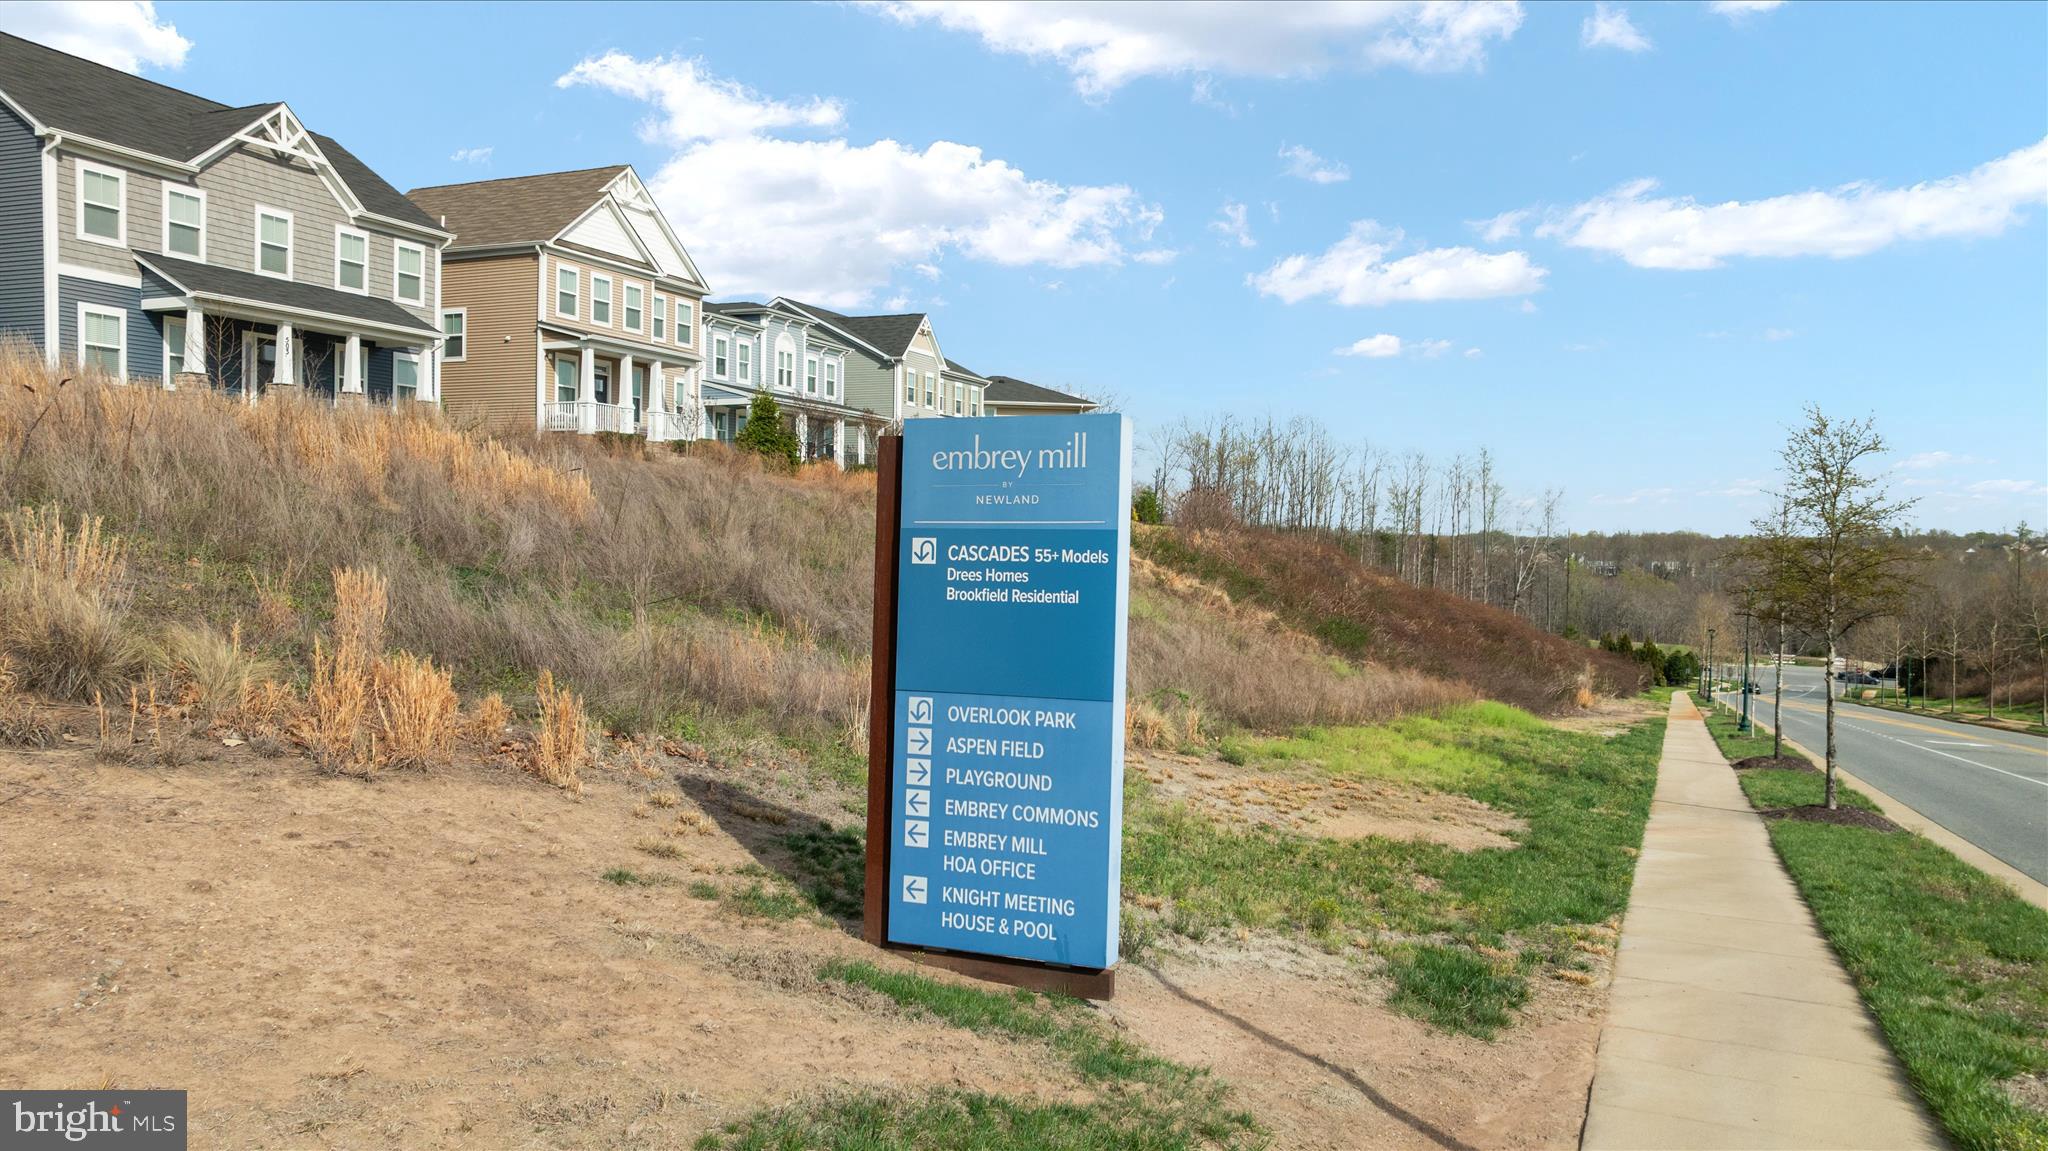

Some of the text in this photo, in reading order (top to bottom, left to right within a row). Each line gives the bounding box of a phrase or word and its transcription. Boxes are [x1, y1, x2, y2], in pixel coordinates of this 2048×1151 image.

[932, 432, 1087, 478] embrey mill
[976, 495, 1039, 505] NEWLAND
[948, 545, 1109, 564] CASCADES 55+ Models
[947, 567, 1029, 582] Drees Homes
[946, 587, 1079, 604] Brookfield Residential
[948, 706, 1077, 730] OVERLOOK PARK
[946, 737, 1045, 759] ASPEN FIELD
[946, 768, 1053, 792] PLAYGROUND
[945, 799, 1099, 828] EMBREY COMMONS
[944, 830, 1048, 855] EMBREY MILL
[943, 855, 1036, 880] HOA OFFICE
[942, 887, 1075, 917] KNIGHT MEETING
[941, 912, 1057, 941] HOUSE & POOL
